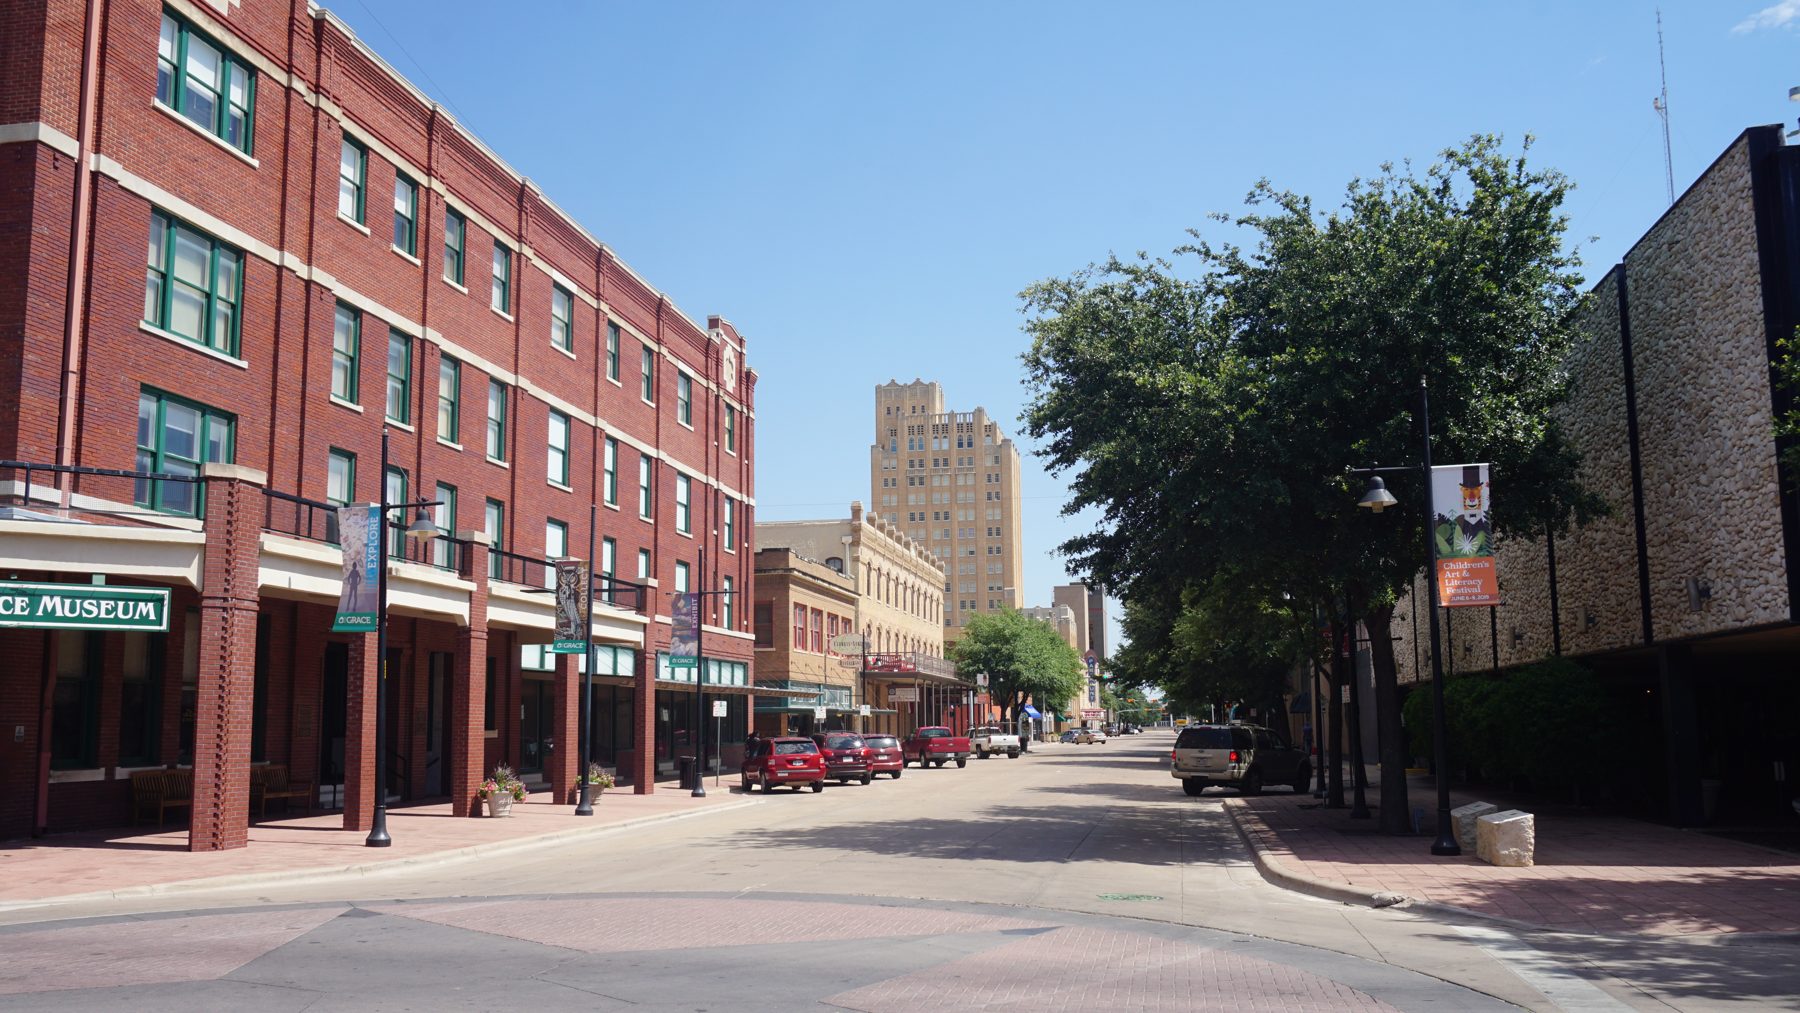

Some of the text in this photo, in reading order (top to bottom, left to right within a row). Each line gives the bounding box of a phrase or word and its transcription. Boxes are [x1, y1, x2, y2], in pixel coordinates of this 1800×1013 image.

[368, 516, 379, 569] EXPLORE
[1443, 561, 1489, 570] Children's
[1446, 586, 1480, 594] Festival
[36, 595, 157, 620] MUSEUM
[346, 616, 371, 624] GRACE
